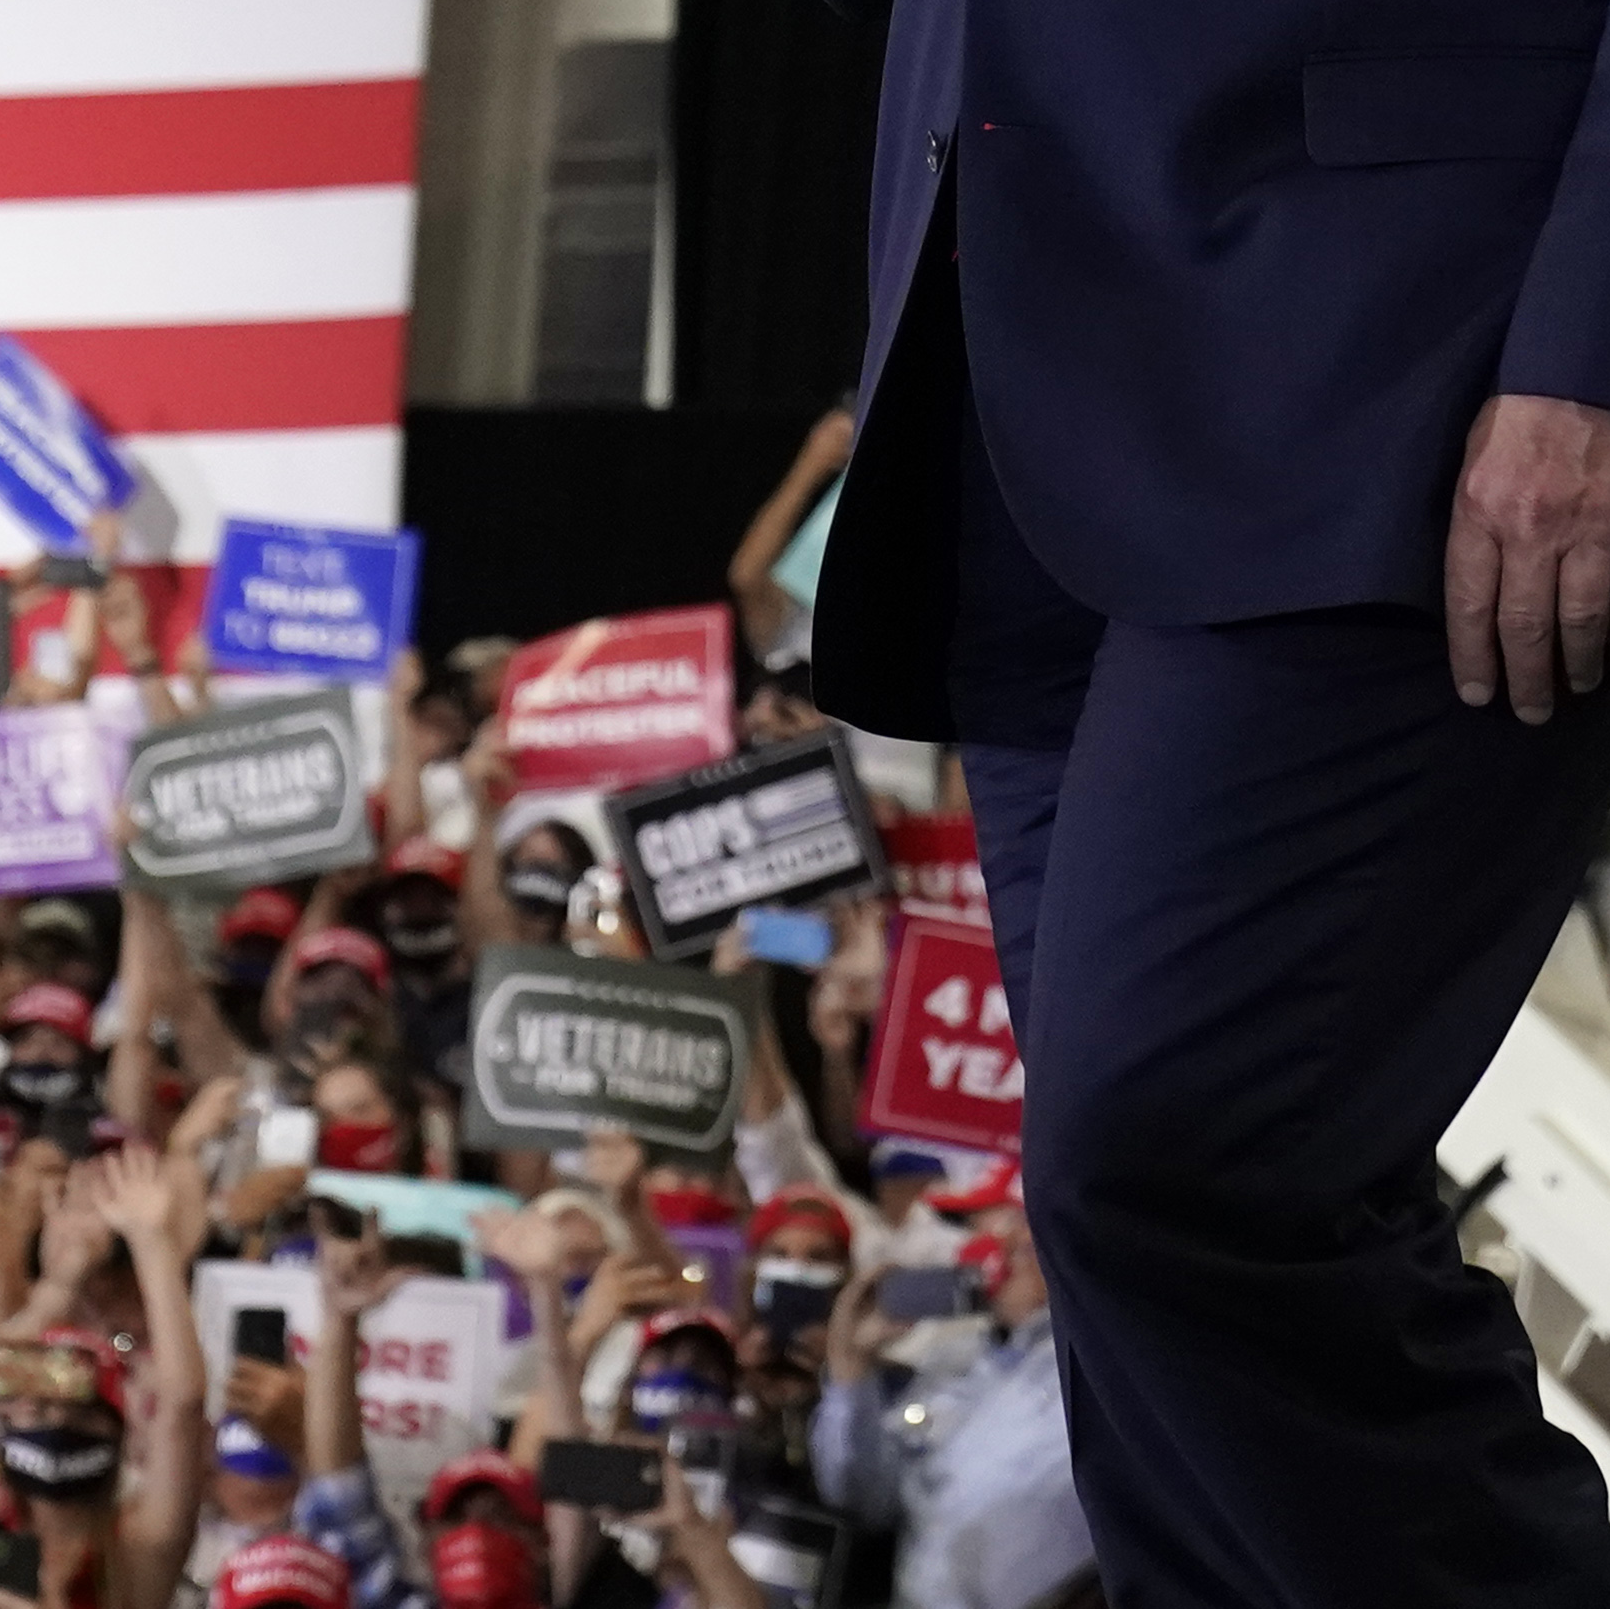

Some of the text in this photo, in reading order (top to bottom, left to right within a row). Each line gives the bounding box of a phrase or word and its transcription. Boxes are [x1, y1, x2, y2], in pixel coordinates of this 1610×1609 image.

[263, 546, 347, 581] TEXT
[244, 580, 363, 618] TRUMP
[513, 660, 702, 708] PEACEFUL
[154, 740, 335, 818] VETERANS
[638, 798, 754, 874] COPS
[923, 976, 971, 1028] 4
[518, 1013, 724, 1088] VETERANS
[920, 1039, 1025, 1102] YEA
